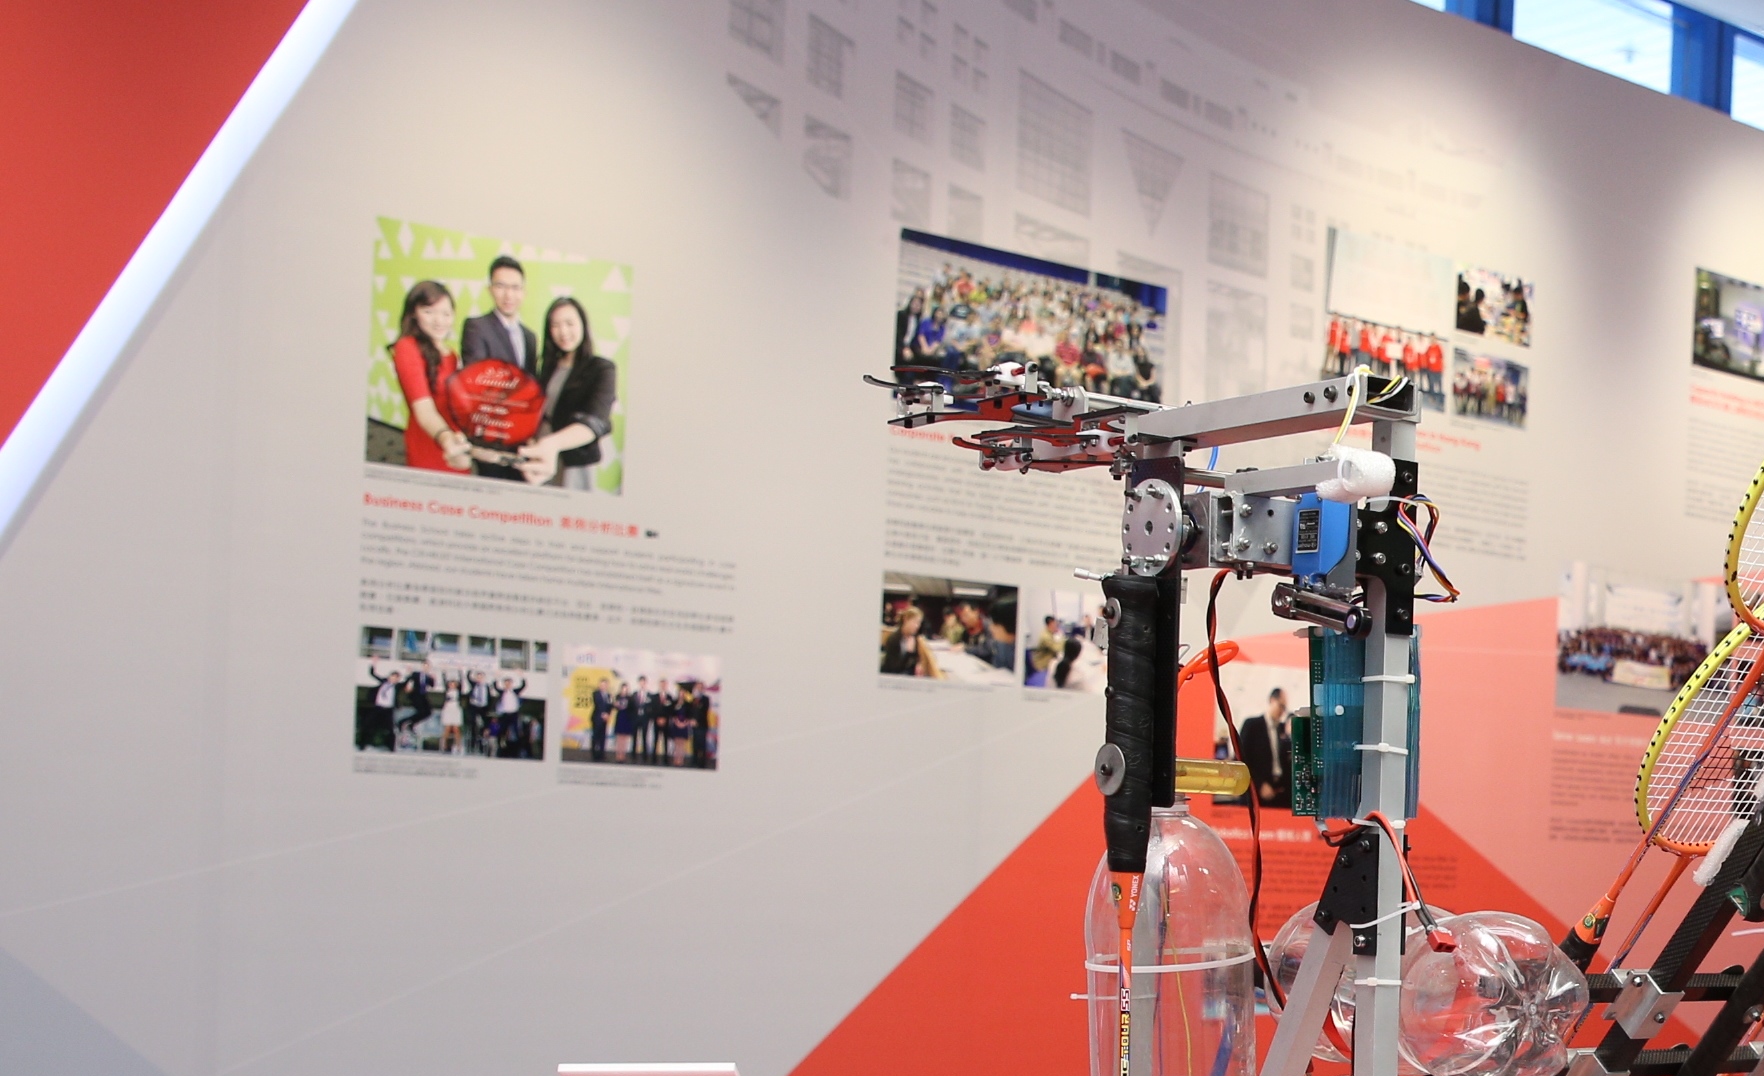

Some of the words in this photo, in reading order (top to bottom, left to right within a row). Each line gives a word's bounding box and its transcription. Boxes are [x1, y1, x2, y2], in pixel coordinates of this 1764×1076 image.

[363, 492, 423, 511] Business
[428, 500, 464, 516] Case
[469, 505, 553, 527] Competition
[1130, 875, 1140, 898] YONEX
[1121, 1013, 1130, 1058] TOUR
